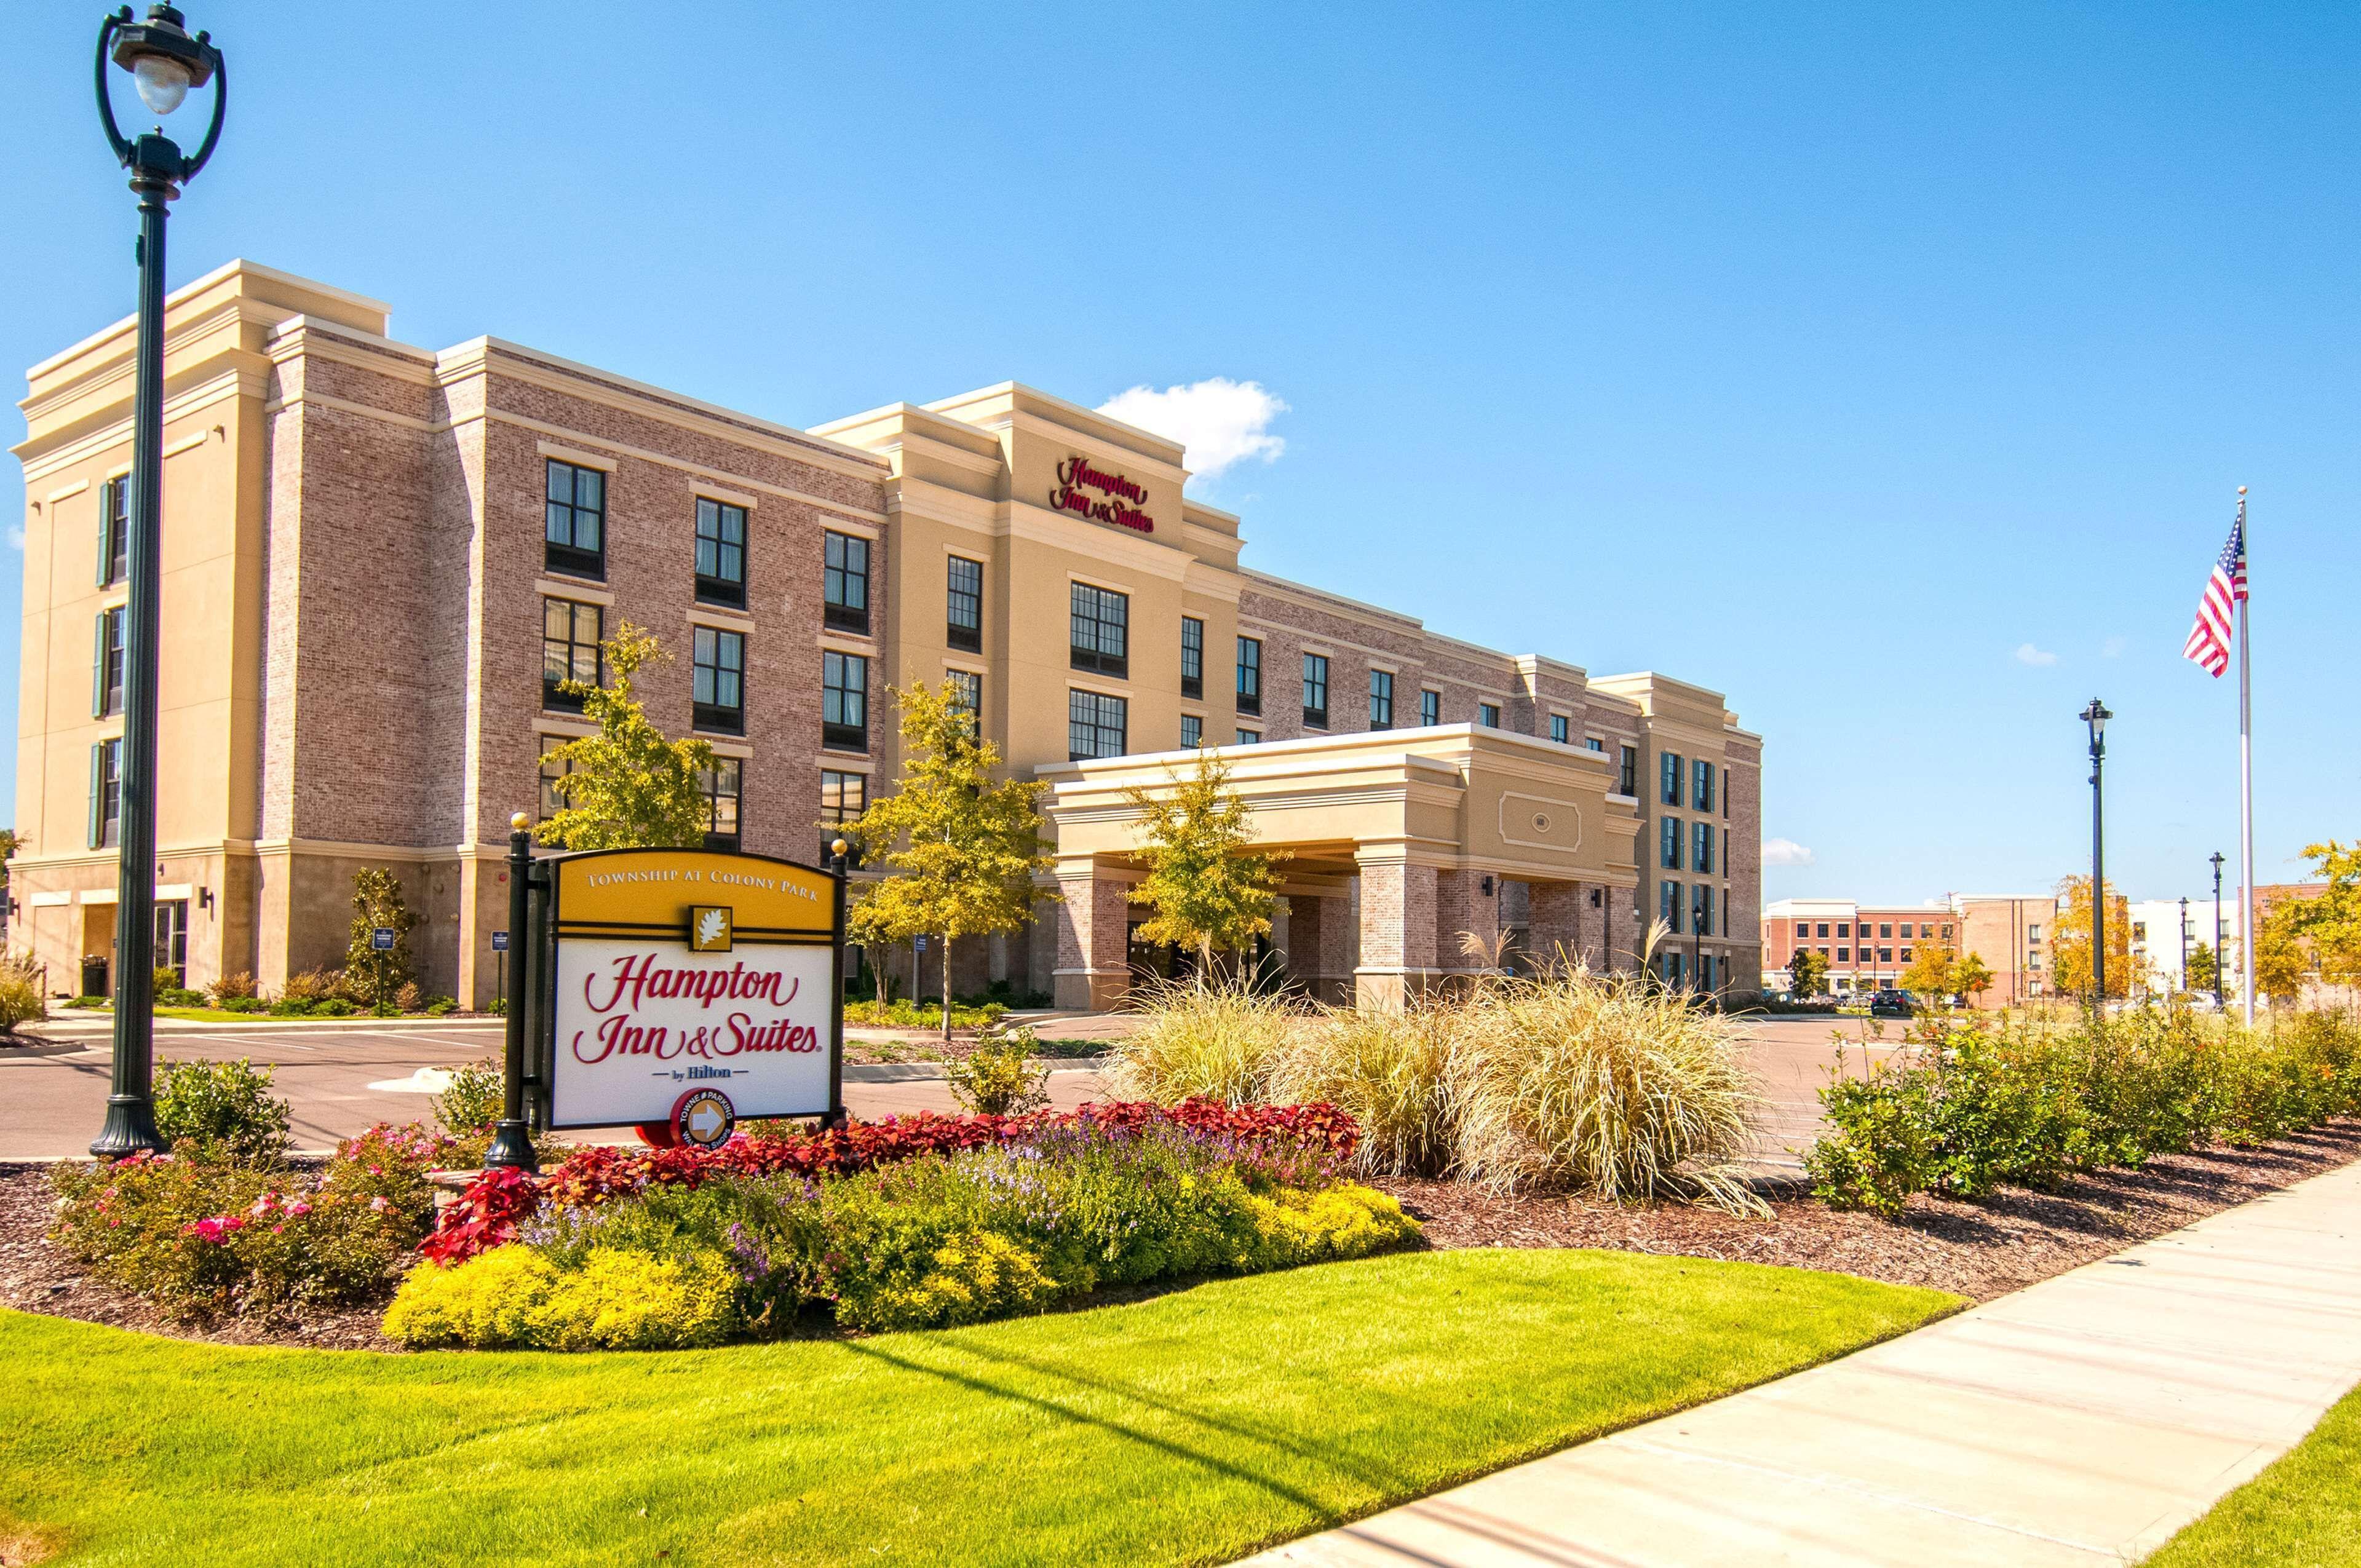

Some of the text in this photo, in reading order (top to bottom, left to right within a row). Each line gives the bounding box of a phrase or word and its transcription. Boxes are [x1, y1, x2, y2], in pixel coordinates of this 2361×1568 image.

[1057, 457, 1148, 505] Hampton
[1049, 486, 1154, 533] Inn & Suites
[587, 870, 817, 901] TOWNSHIP AT COLONY PARK
[584, 953, 798, 1013] Hampton
[574, 1014, 686, 1064] Inn
[687, 1026, 713, 1059] &
[672, 1065, 731, 1082] by Hilton
[680, 1091, 733, 1123] TOWNE PARKING
[711, 1128, 731, 1149] SHOPS
